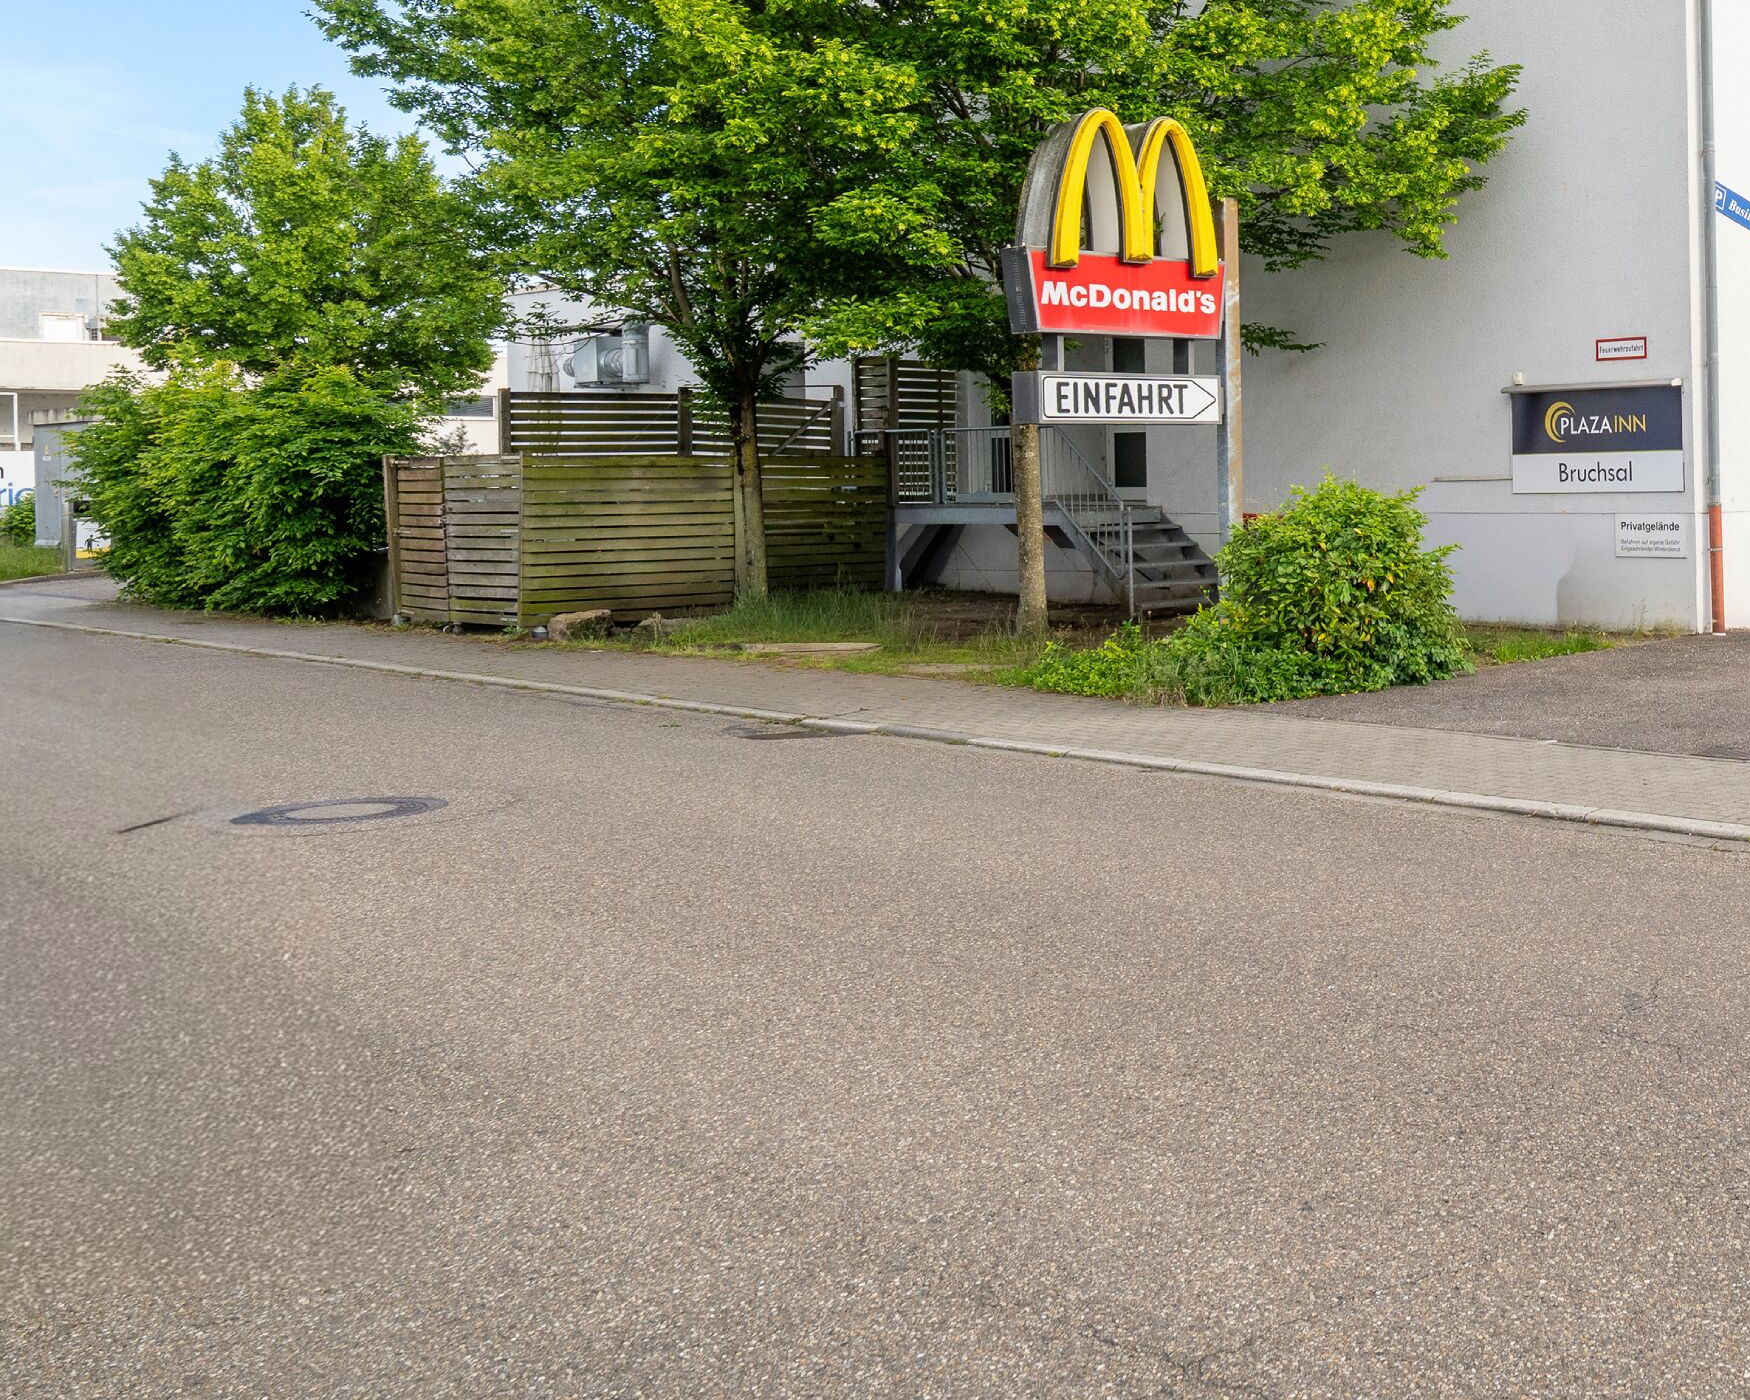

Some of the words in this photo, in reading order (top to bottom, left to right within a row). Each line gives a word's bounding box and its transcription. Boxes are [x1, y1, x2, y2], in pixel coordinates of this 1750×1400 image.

[1041, 280, 1217, 314] McDonald's
[1056, 381, 1188, 415] EINFAHRT
[1559, 460, 1633, 482] Bruchsal
[1620, 521, 1680, 532] Privatgelände
